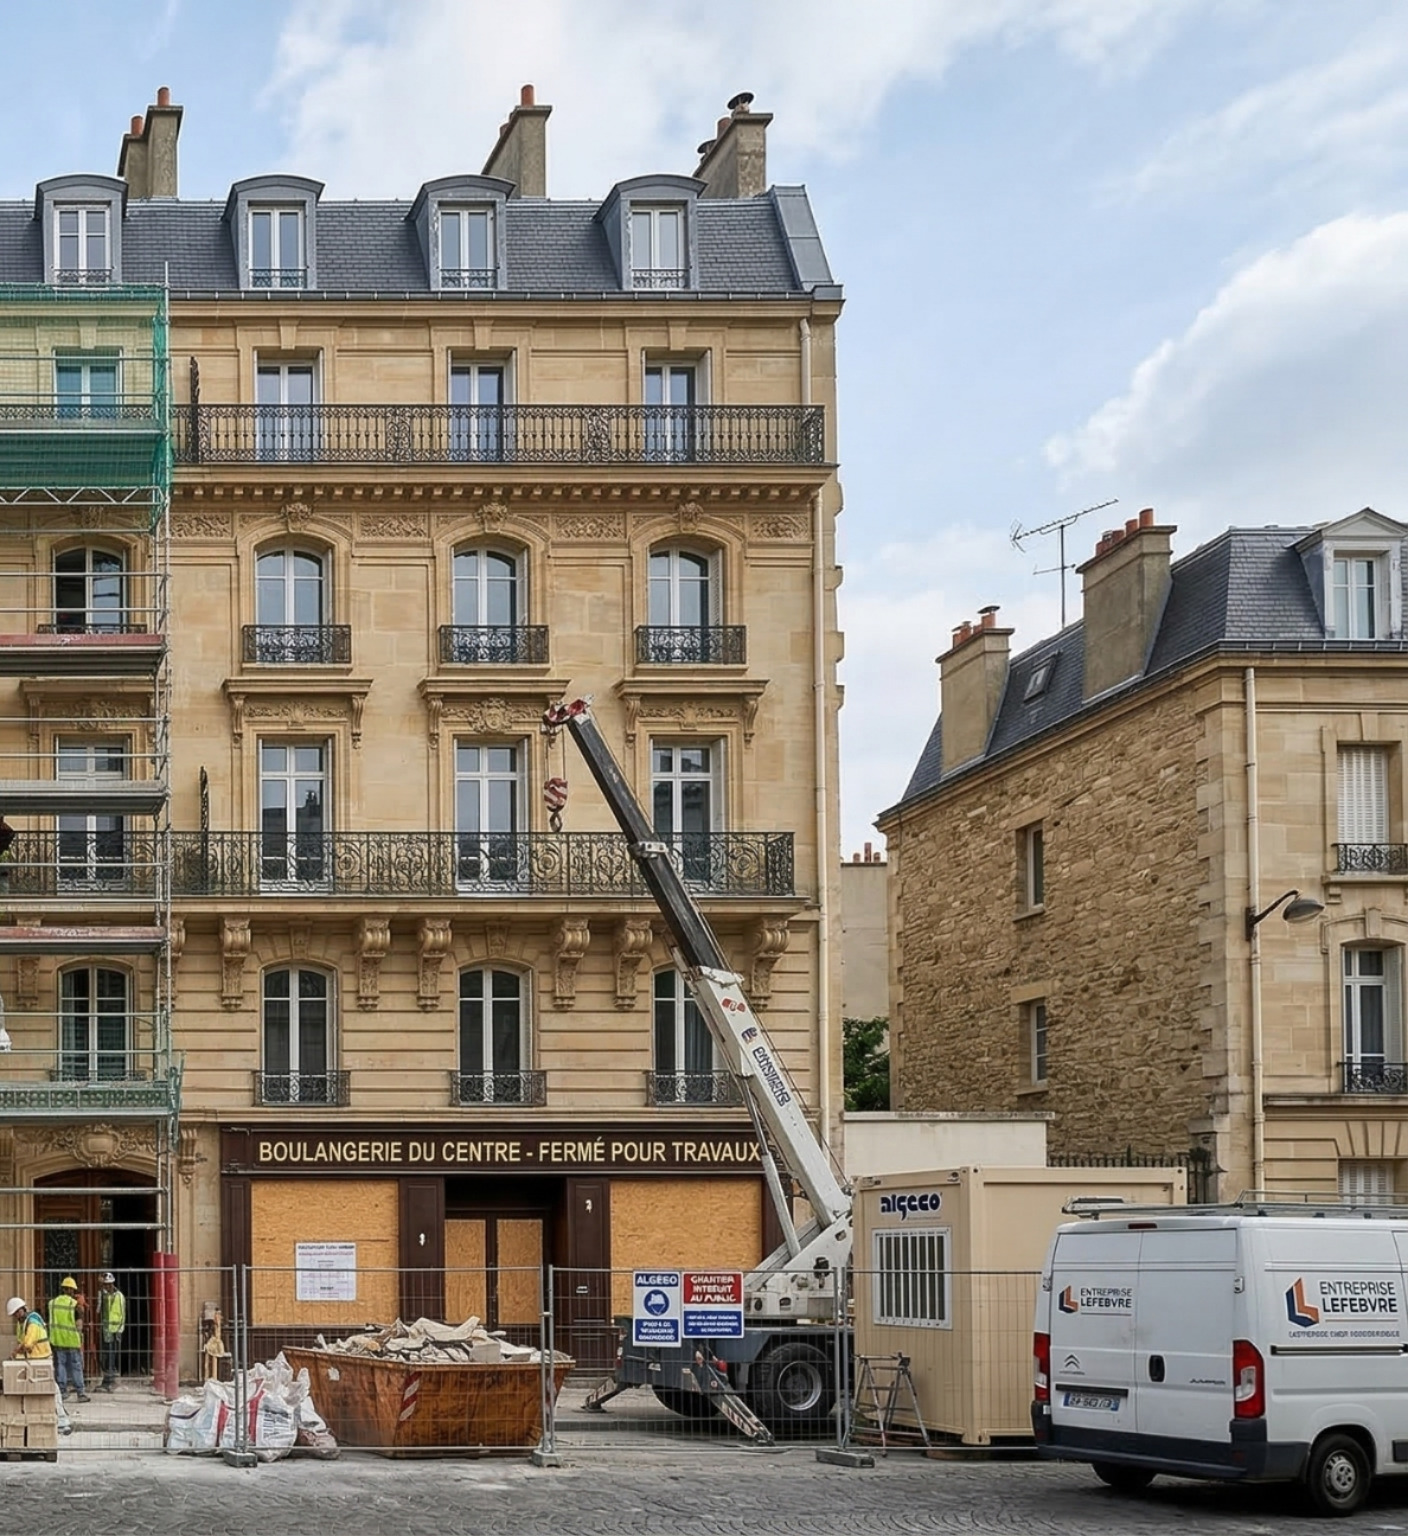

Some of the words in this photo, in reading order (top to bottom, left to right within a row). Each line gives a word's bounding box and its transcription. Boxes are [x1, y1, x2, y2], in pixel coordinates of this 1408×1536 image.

[259, 1142, 403, 1162] BOULANGERIE
[408, 1142, 435, 1162] DU
[442, 1141, 521, 1162] CENTRE
[538, 1136, 605, 1162] FERMÉ
[611, 1142, 666, 1162] POUR
[672, 1142, 761, 1162] TRAVAUX
[1080, 1287, 1133, 1297] ENTREPRISE
[1319, 1281, 1396, 1296] ENTREPRISE
[1080, 1297, 1133, 1308] LEFEBVRE
[1322, 1297, 1399, 1313] LEFEBVRE
